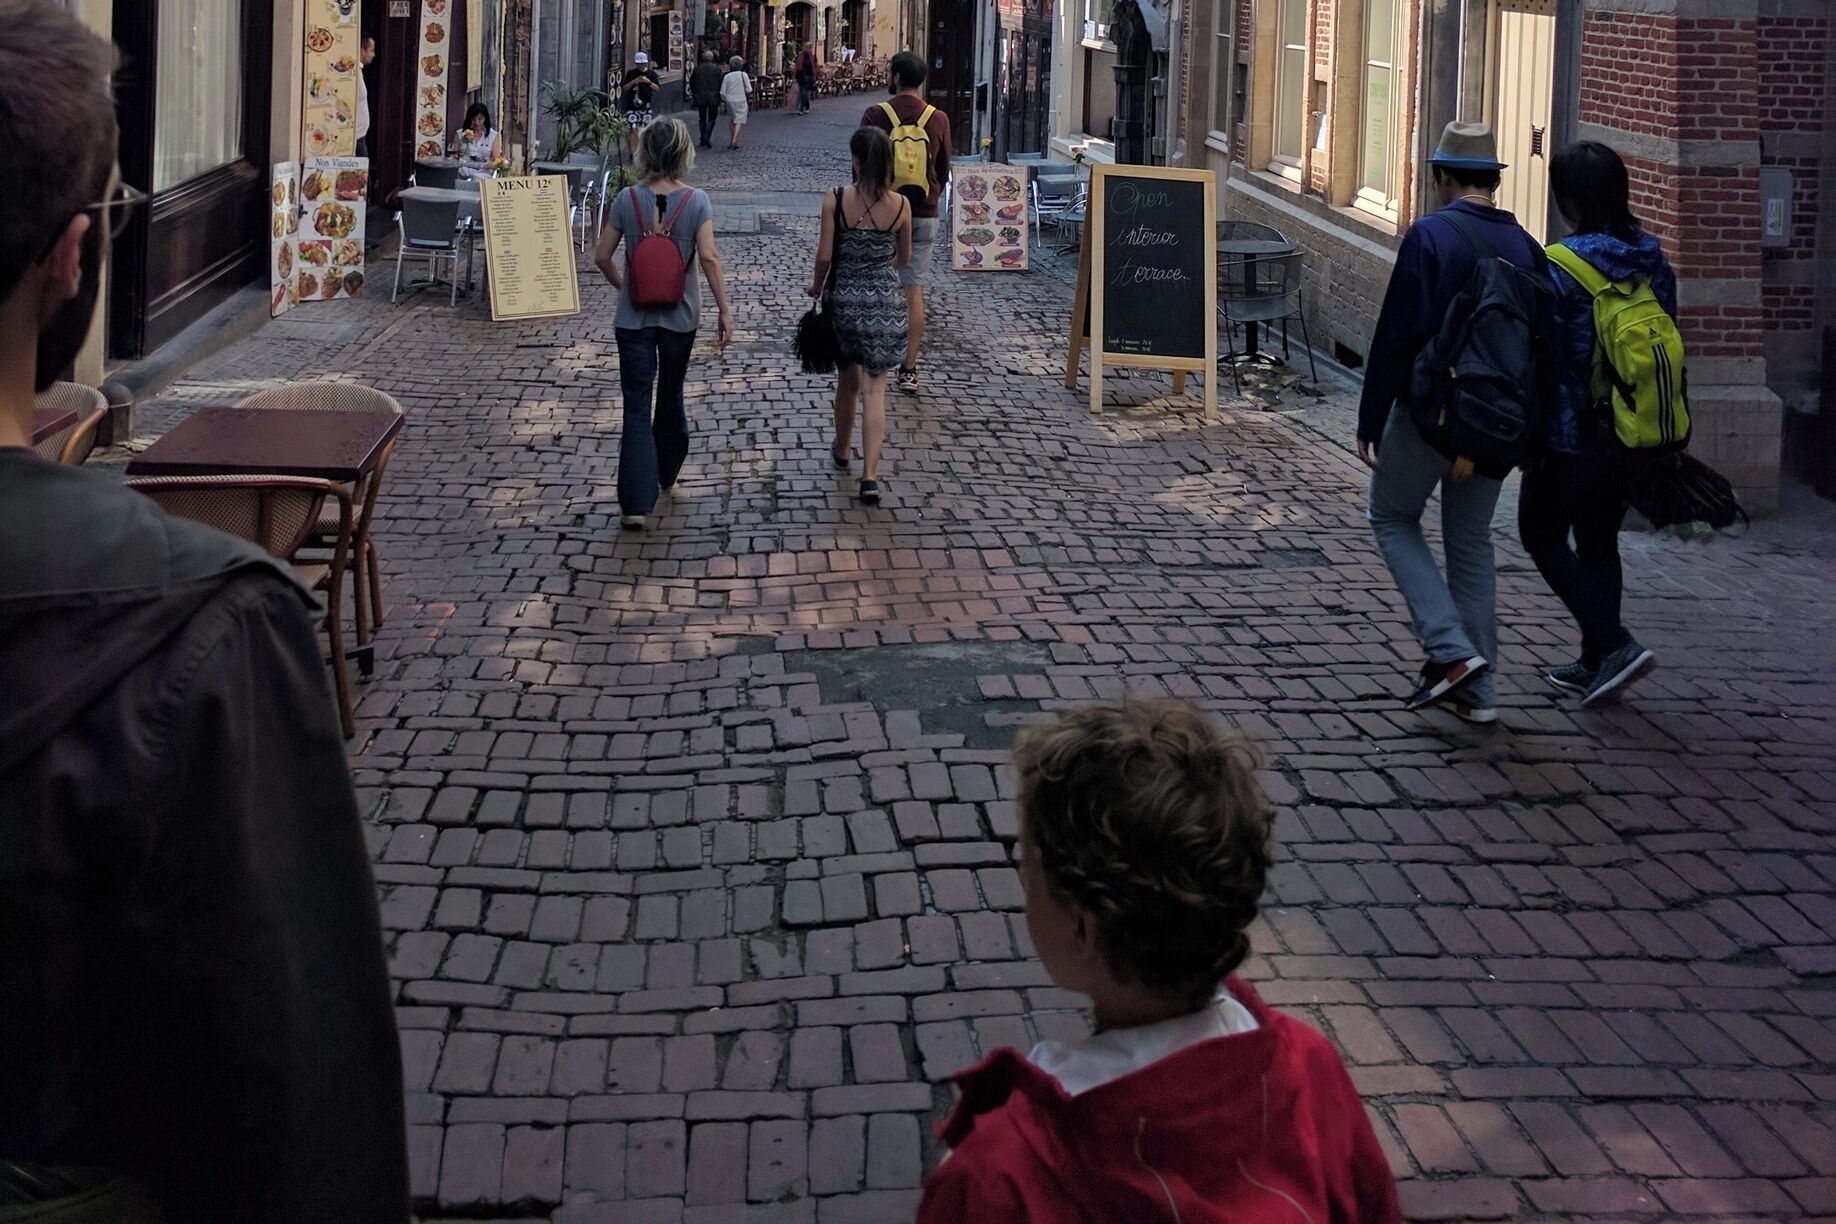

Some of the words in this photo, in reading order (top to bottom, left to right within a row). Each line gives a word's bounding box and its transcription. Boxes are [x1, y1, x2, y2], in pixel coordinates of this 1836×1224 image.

[315, 158, 329, 167] Nos
[332, 158, 359, 168] Viandes
[497, 179, 533, 191] MENU
[1110, 182, 1174, 222] Open
[1110, 224, 1179, 246] interior
